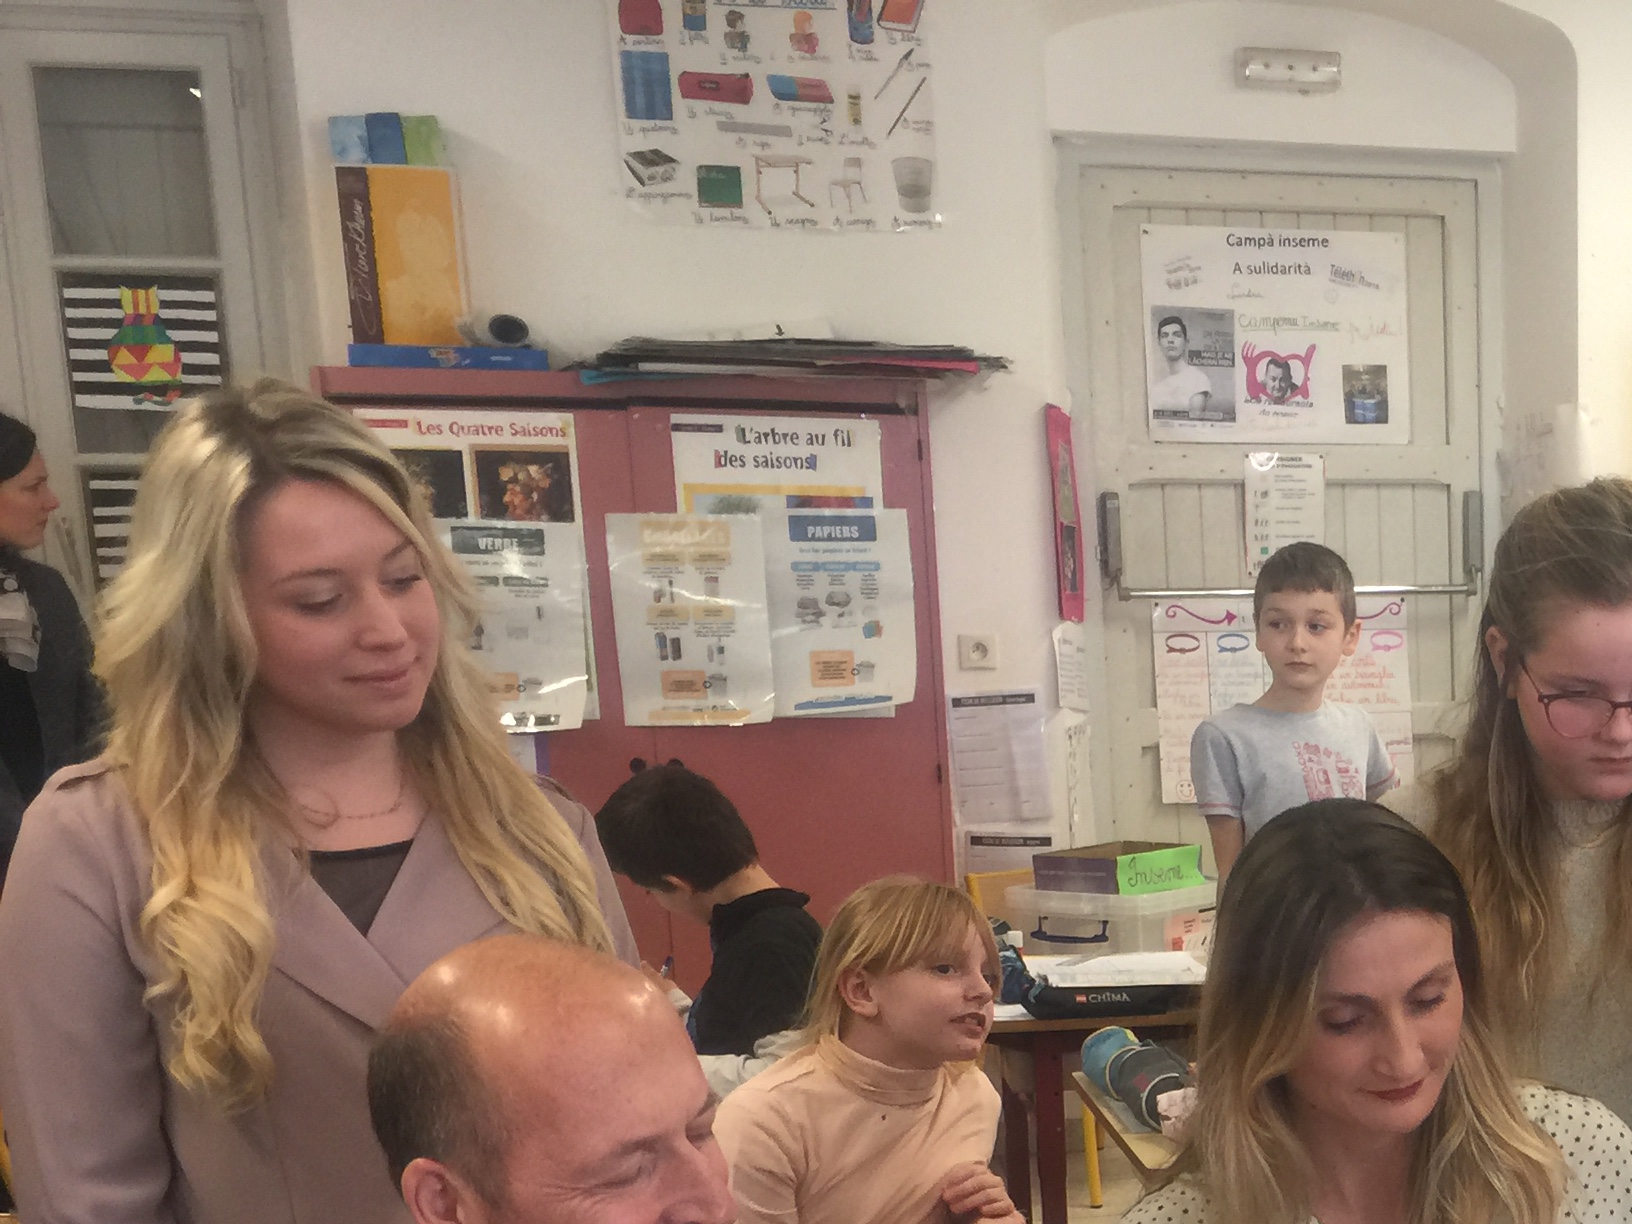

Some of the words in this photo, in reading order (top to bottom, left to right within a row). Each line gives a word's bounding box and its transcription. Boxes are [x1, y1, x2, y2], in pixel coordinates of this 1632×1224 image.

[1226, 233, 1275, 250] Campà
[1278, 235, 1329, 249] inseme
[1233, 262, 1243, 275] A
[1246, 261, 1312, 275] sulidarità
[417, 421, 443, 435] Les
[449, 421, 504, 437] Quatre
[509, 422, 566, 438] Saisons
[742, 427, 799, 446] L'arbre
[806, 434, 826, 446] au
[833, 428, 852, 448] fil
[718, 452, 746, 468] des
[753, 452, 812, 470] saisons
[807, 525, 859, 538] PAPIERS
